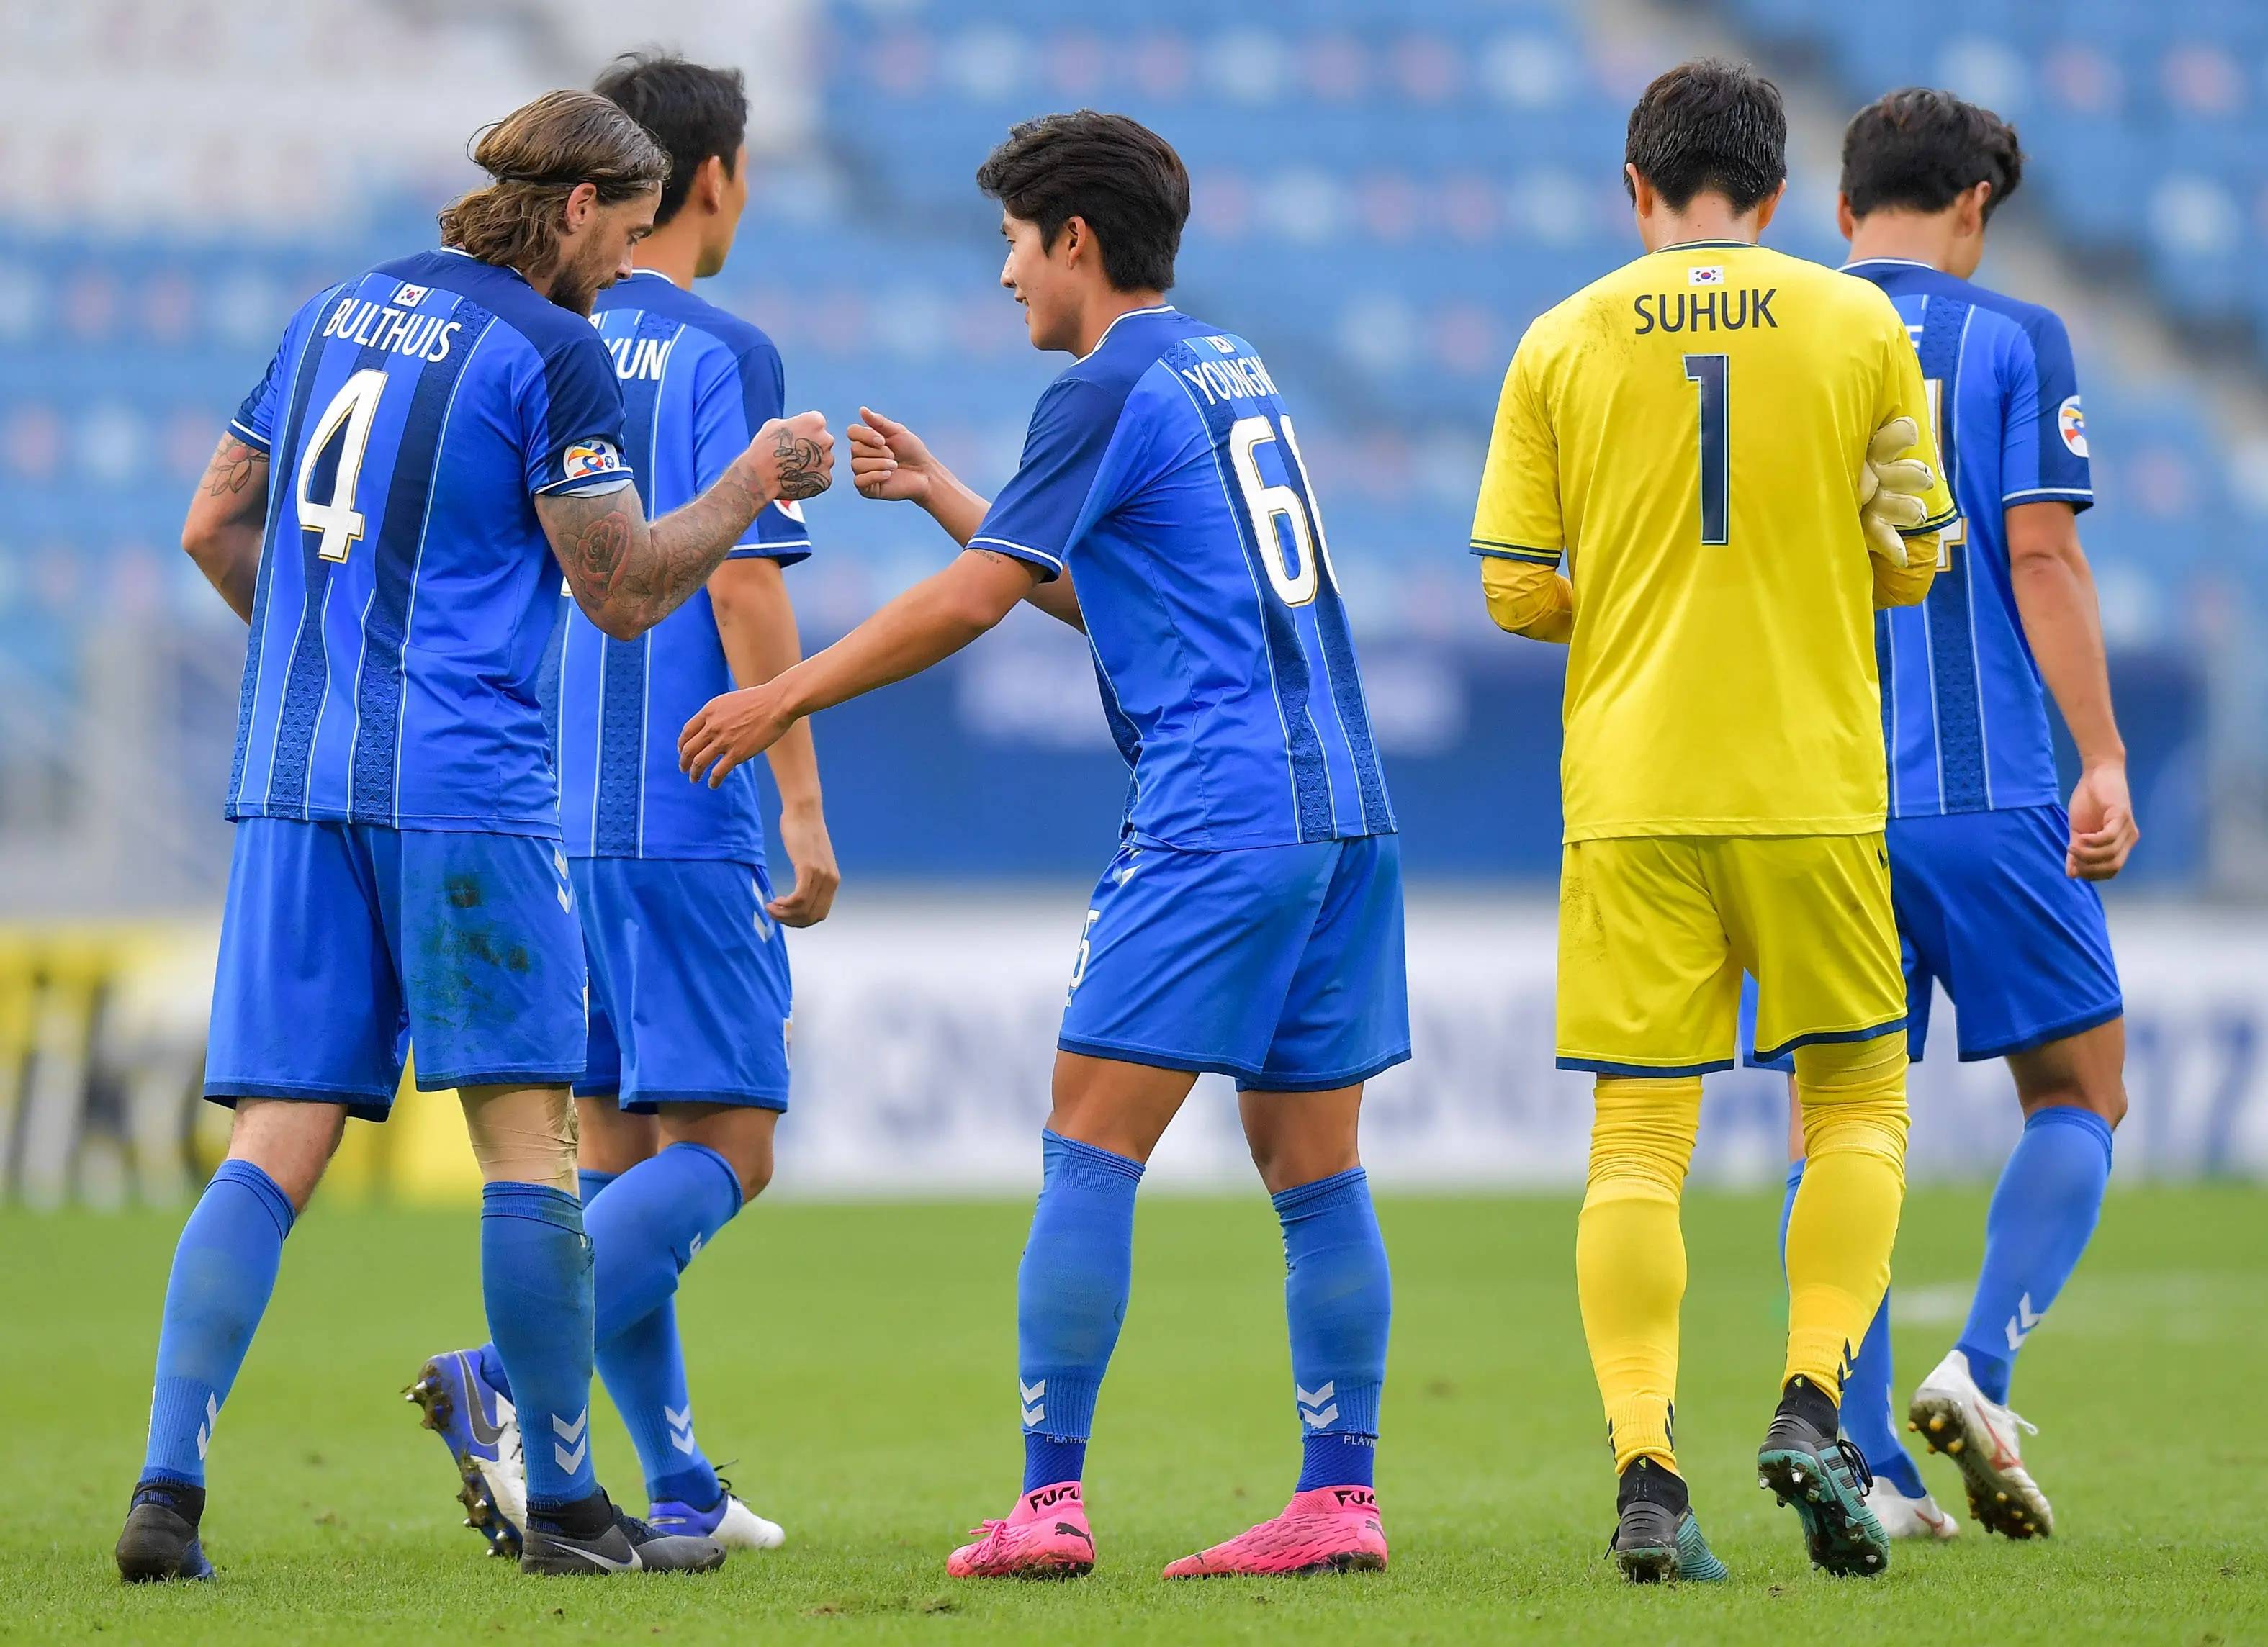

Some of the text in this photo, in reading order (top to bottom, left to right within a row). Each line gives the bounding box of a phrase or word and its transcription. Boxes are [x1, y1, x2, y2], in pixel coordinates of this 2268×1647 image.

[322, 297, 462, 363] BULTHUIS
[1634, 288, 1778, 335] SUHUK
[296, 368, 388, 564] 4
[1683, 353, 1729, 546] 1
